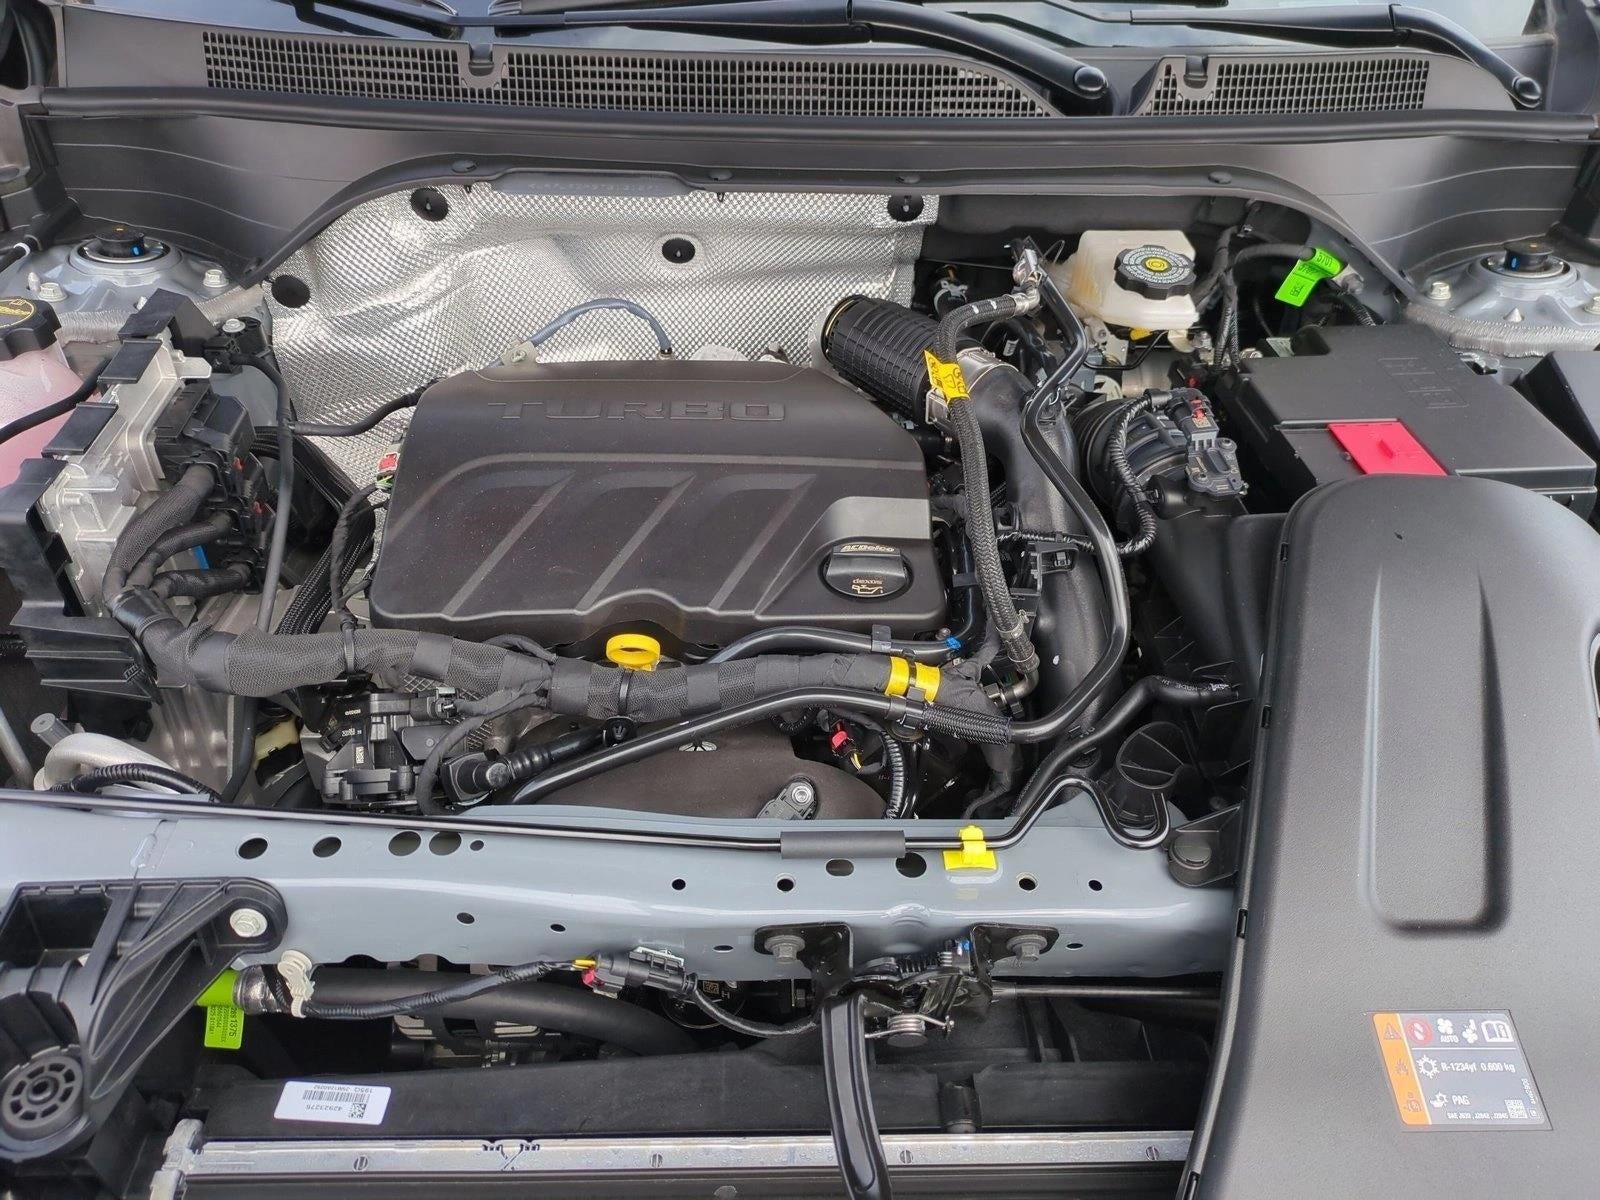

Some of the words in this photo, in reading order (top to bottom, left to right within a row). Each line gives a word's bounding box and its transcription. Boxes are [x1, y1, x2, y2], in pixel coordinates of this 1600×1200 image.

[487, 400, 785, 421] TURBO
[840, 544, 895, 553] ACDelco
[1504, 1062, 1515, 1073] kg
[1451, 1095, 1471, 1105] PAG
